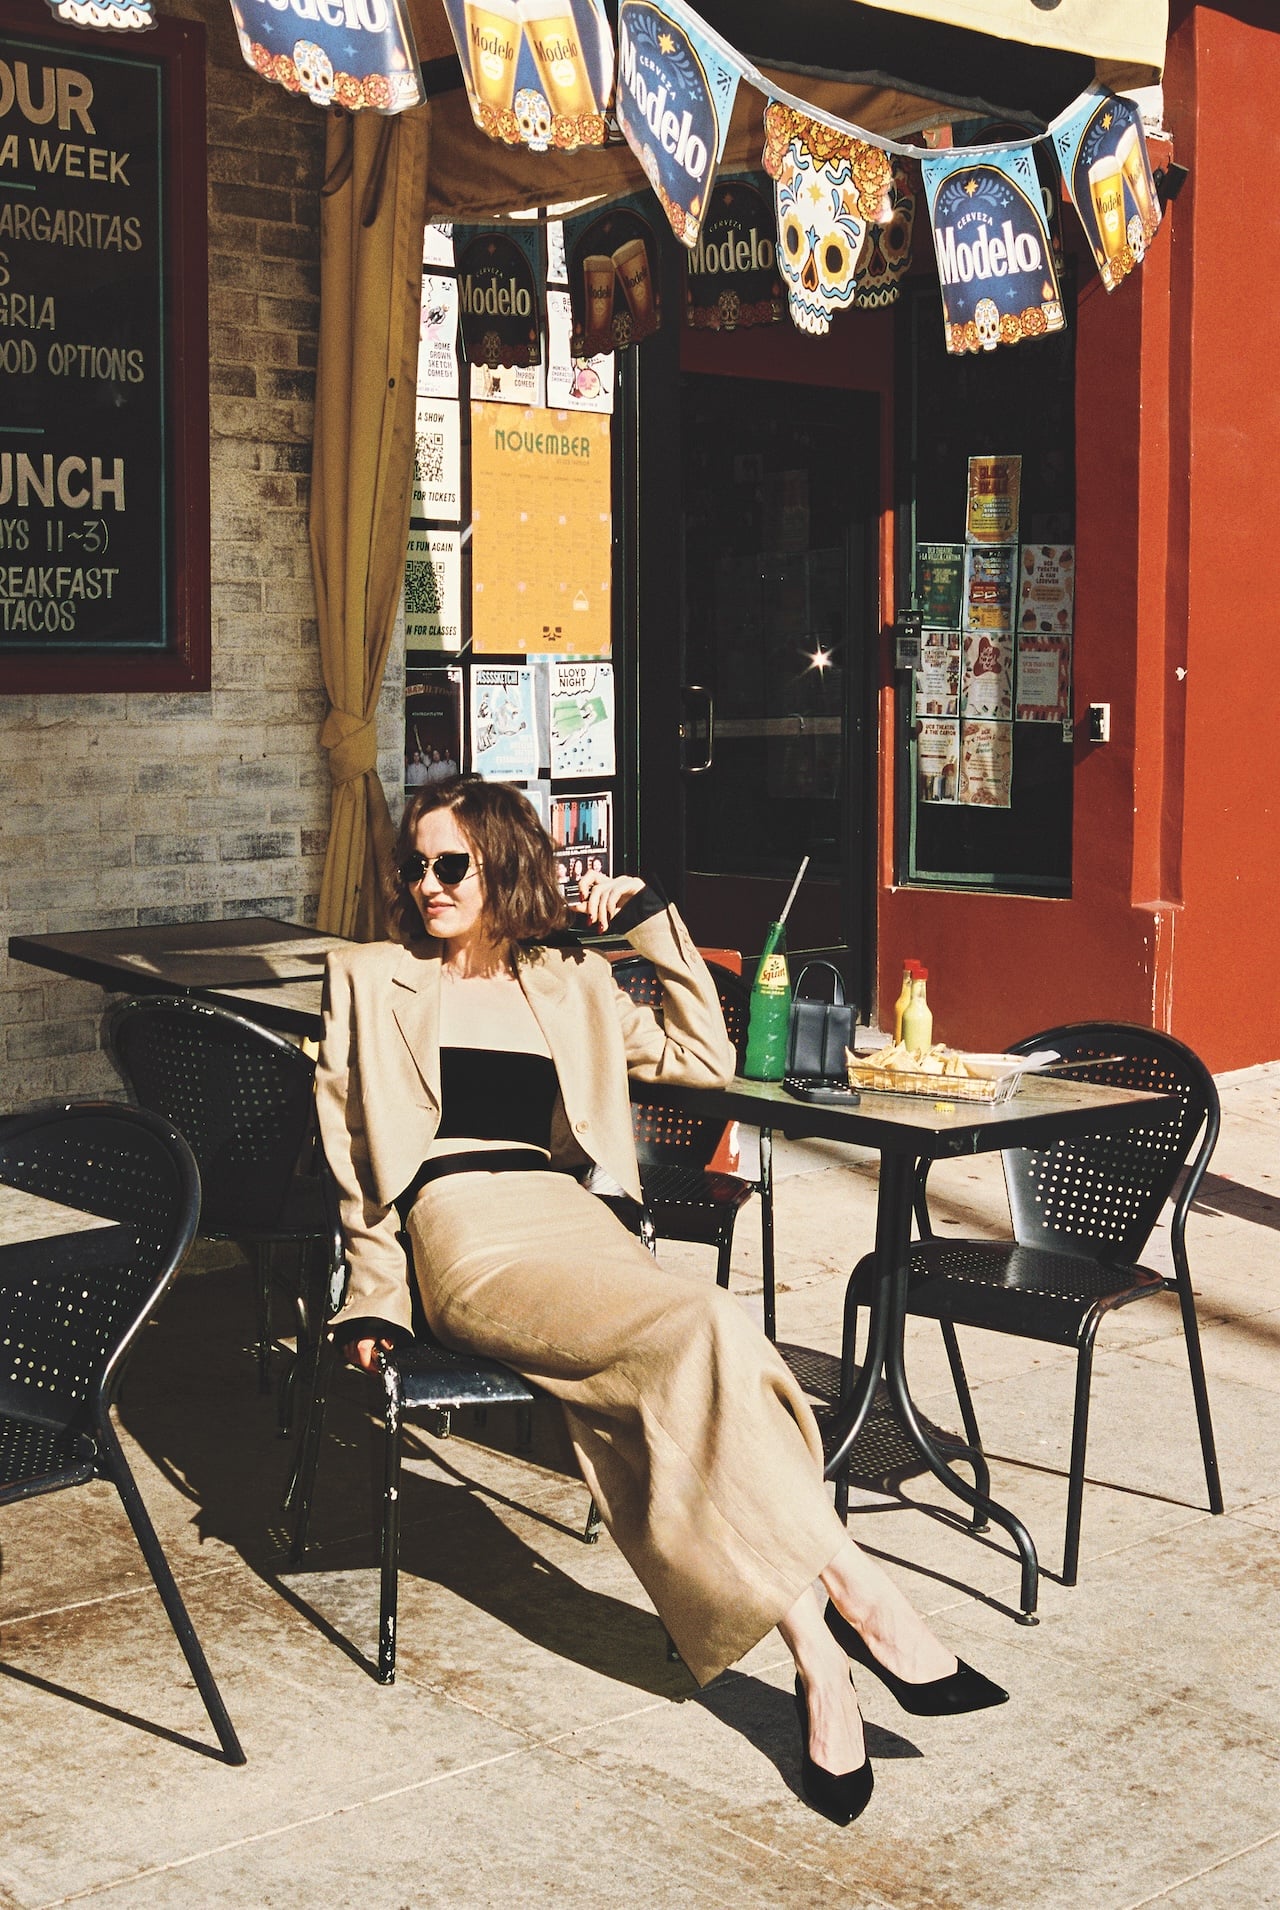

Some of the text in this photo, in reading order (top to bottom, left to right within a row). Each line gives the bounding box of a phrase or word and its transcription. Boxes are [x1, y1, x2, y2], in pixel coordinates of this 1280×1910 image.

[471, 23, 514, 61] Modelo
[534, 38, 578, 62] Modelo
[639, 54, 676, 100] CERVEZA
[28, 137, 130, 186] WEEK
[957, 212, 993, 230] CERVEZA
[458, 273, 531, 317] Modelo
[434, 342, 450, 351] HOME
[48, 342, 144, 383] OPTIONS
[428, 369, 453, 378] COMEDY
[514, 379, 535, 388] COMEDY
[417, 412, 444, 423] A SHOW
[495, 429, 590, 458] NOVEMBER
[413, 490, 456, 502] FOR TICKETS
[416, 541, 430, 552] FUN
[431, 542, 454, 552] AGAIN
[0, 598, 76, 632] TACOS
[414, 625, 427, 635] FOR
[428, 626, 457, 636] CLASSES
[558, 668, 587, 678] LLOYD
[559, 677, 586, 687] NIGHT
